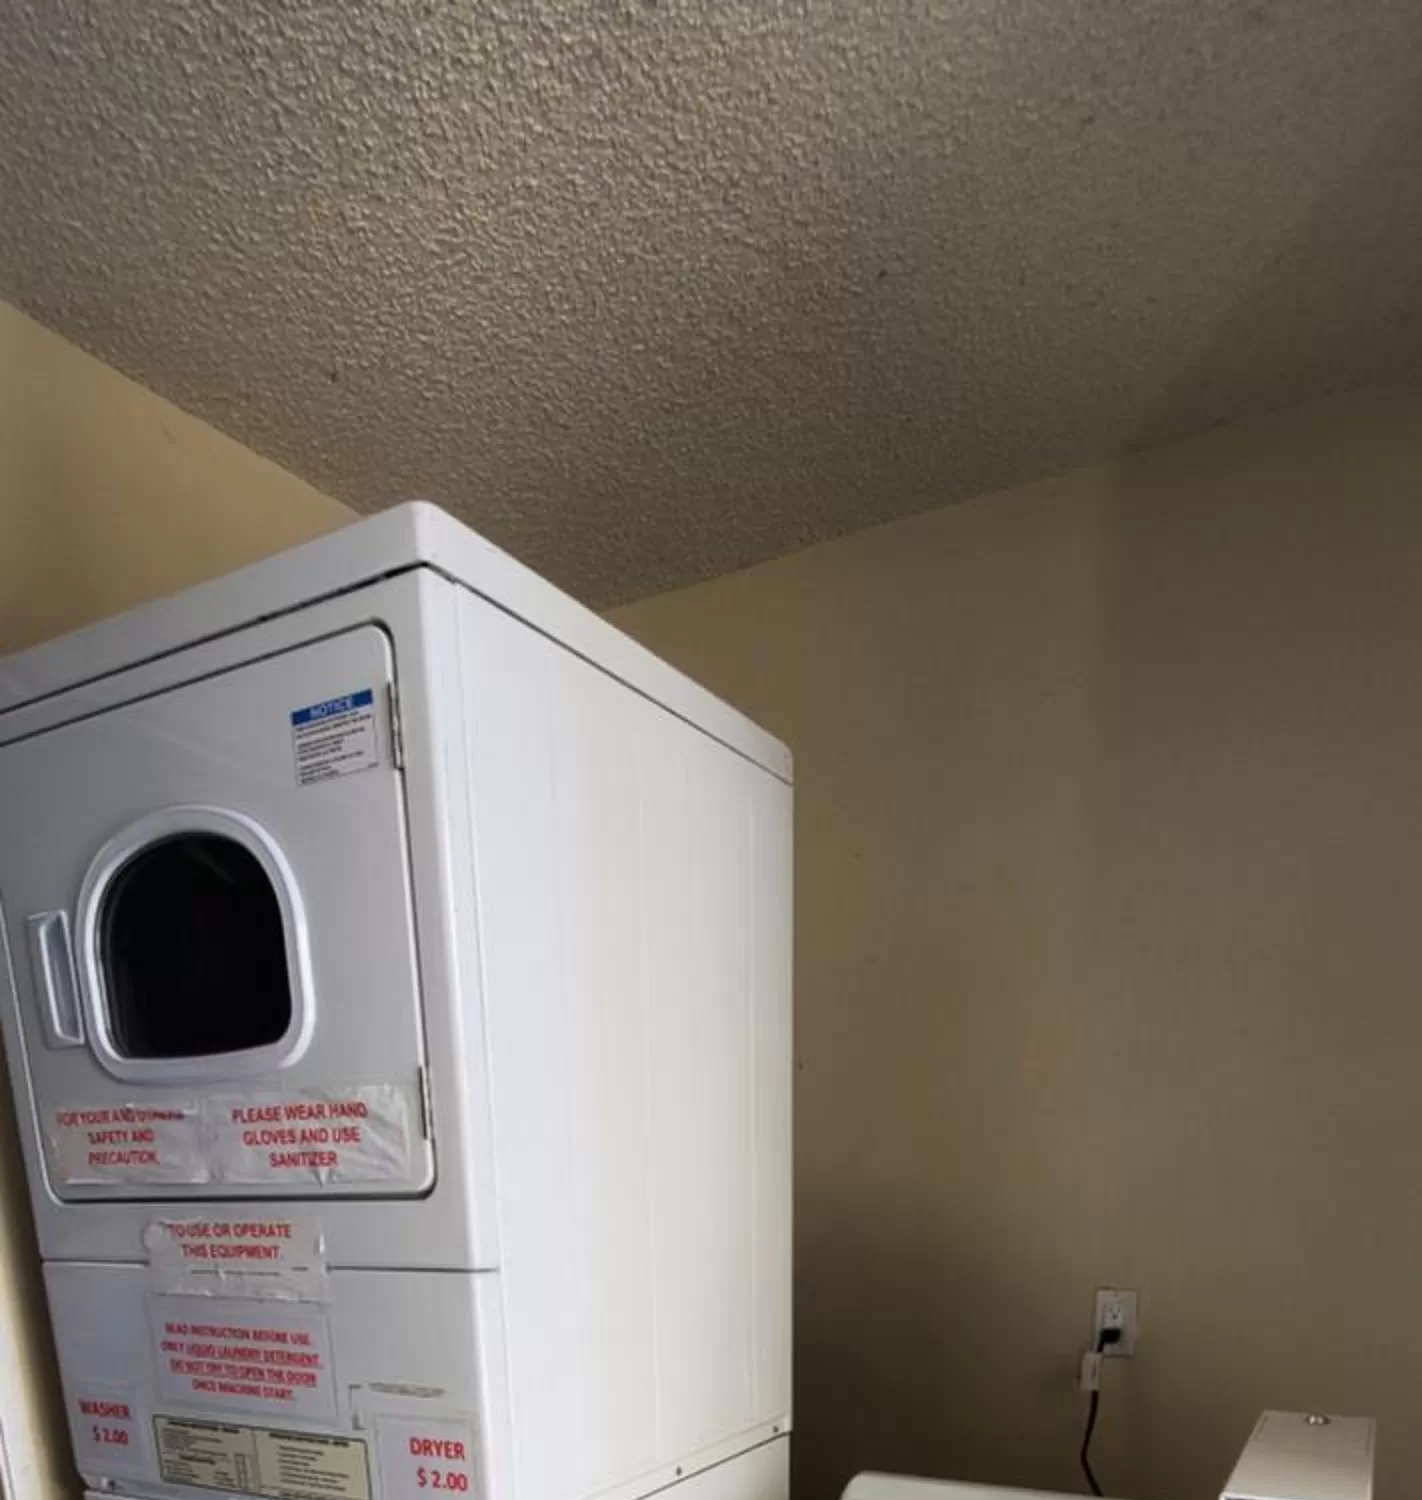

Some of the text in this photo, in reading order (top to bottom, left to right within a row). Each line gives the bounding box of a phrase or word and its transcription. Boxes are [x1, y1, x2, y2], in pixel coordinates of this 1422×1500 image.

[230, 1101, 368, 1123] PLEASE WEAR HAND
[88, 1129, 128, 1145] SAFETY
[243, 1125, 361, 1146] GLOVES AND USE
[269, 1150, 338, 1168] SANITIZER
[211, 1222, 230, 1238] OR
[232, 1222, 291, 1239] OPERATE
[181, 1243, 207, 1258] THIS
[77, 1398, 132, 1421] WASHER
[102, 1427, 129, 1446] 2.00
[409, 1436, 466, 1462] DRYER
[417, 1466, 469, 1493] $ 2.00
